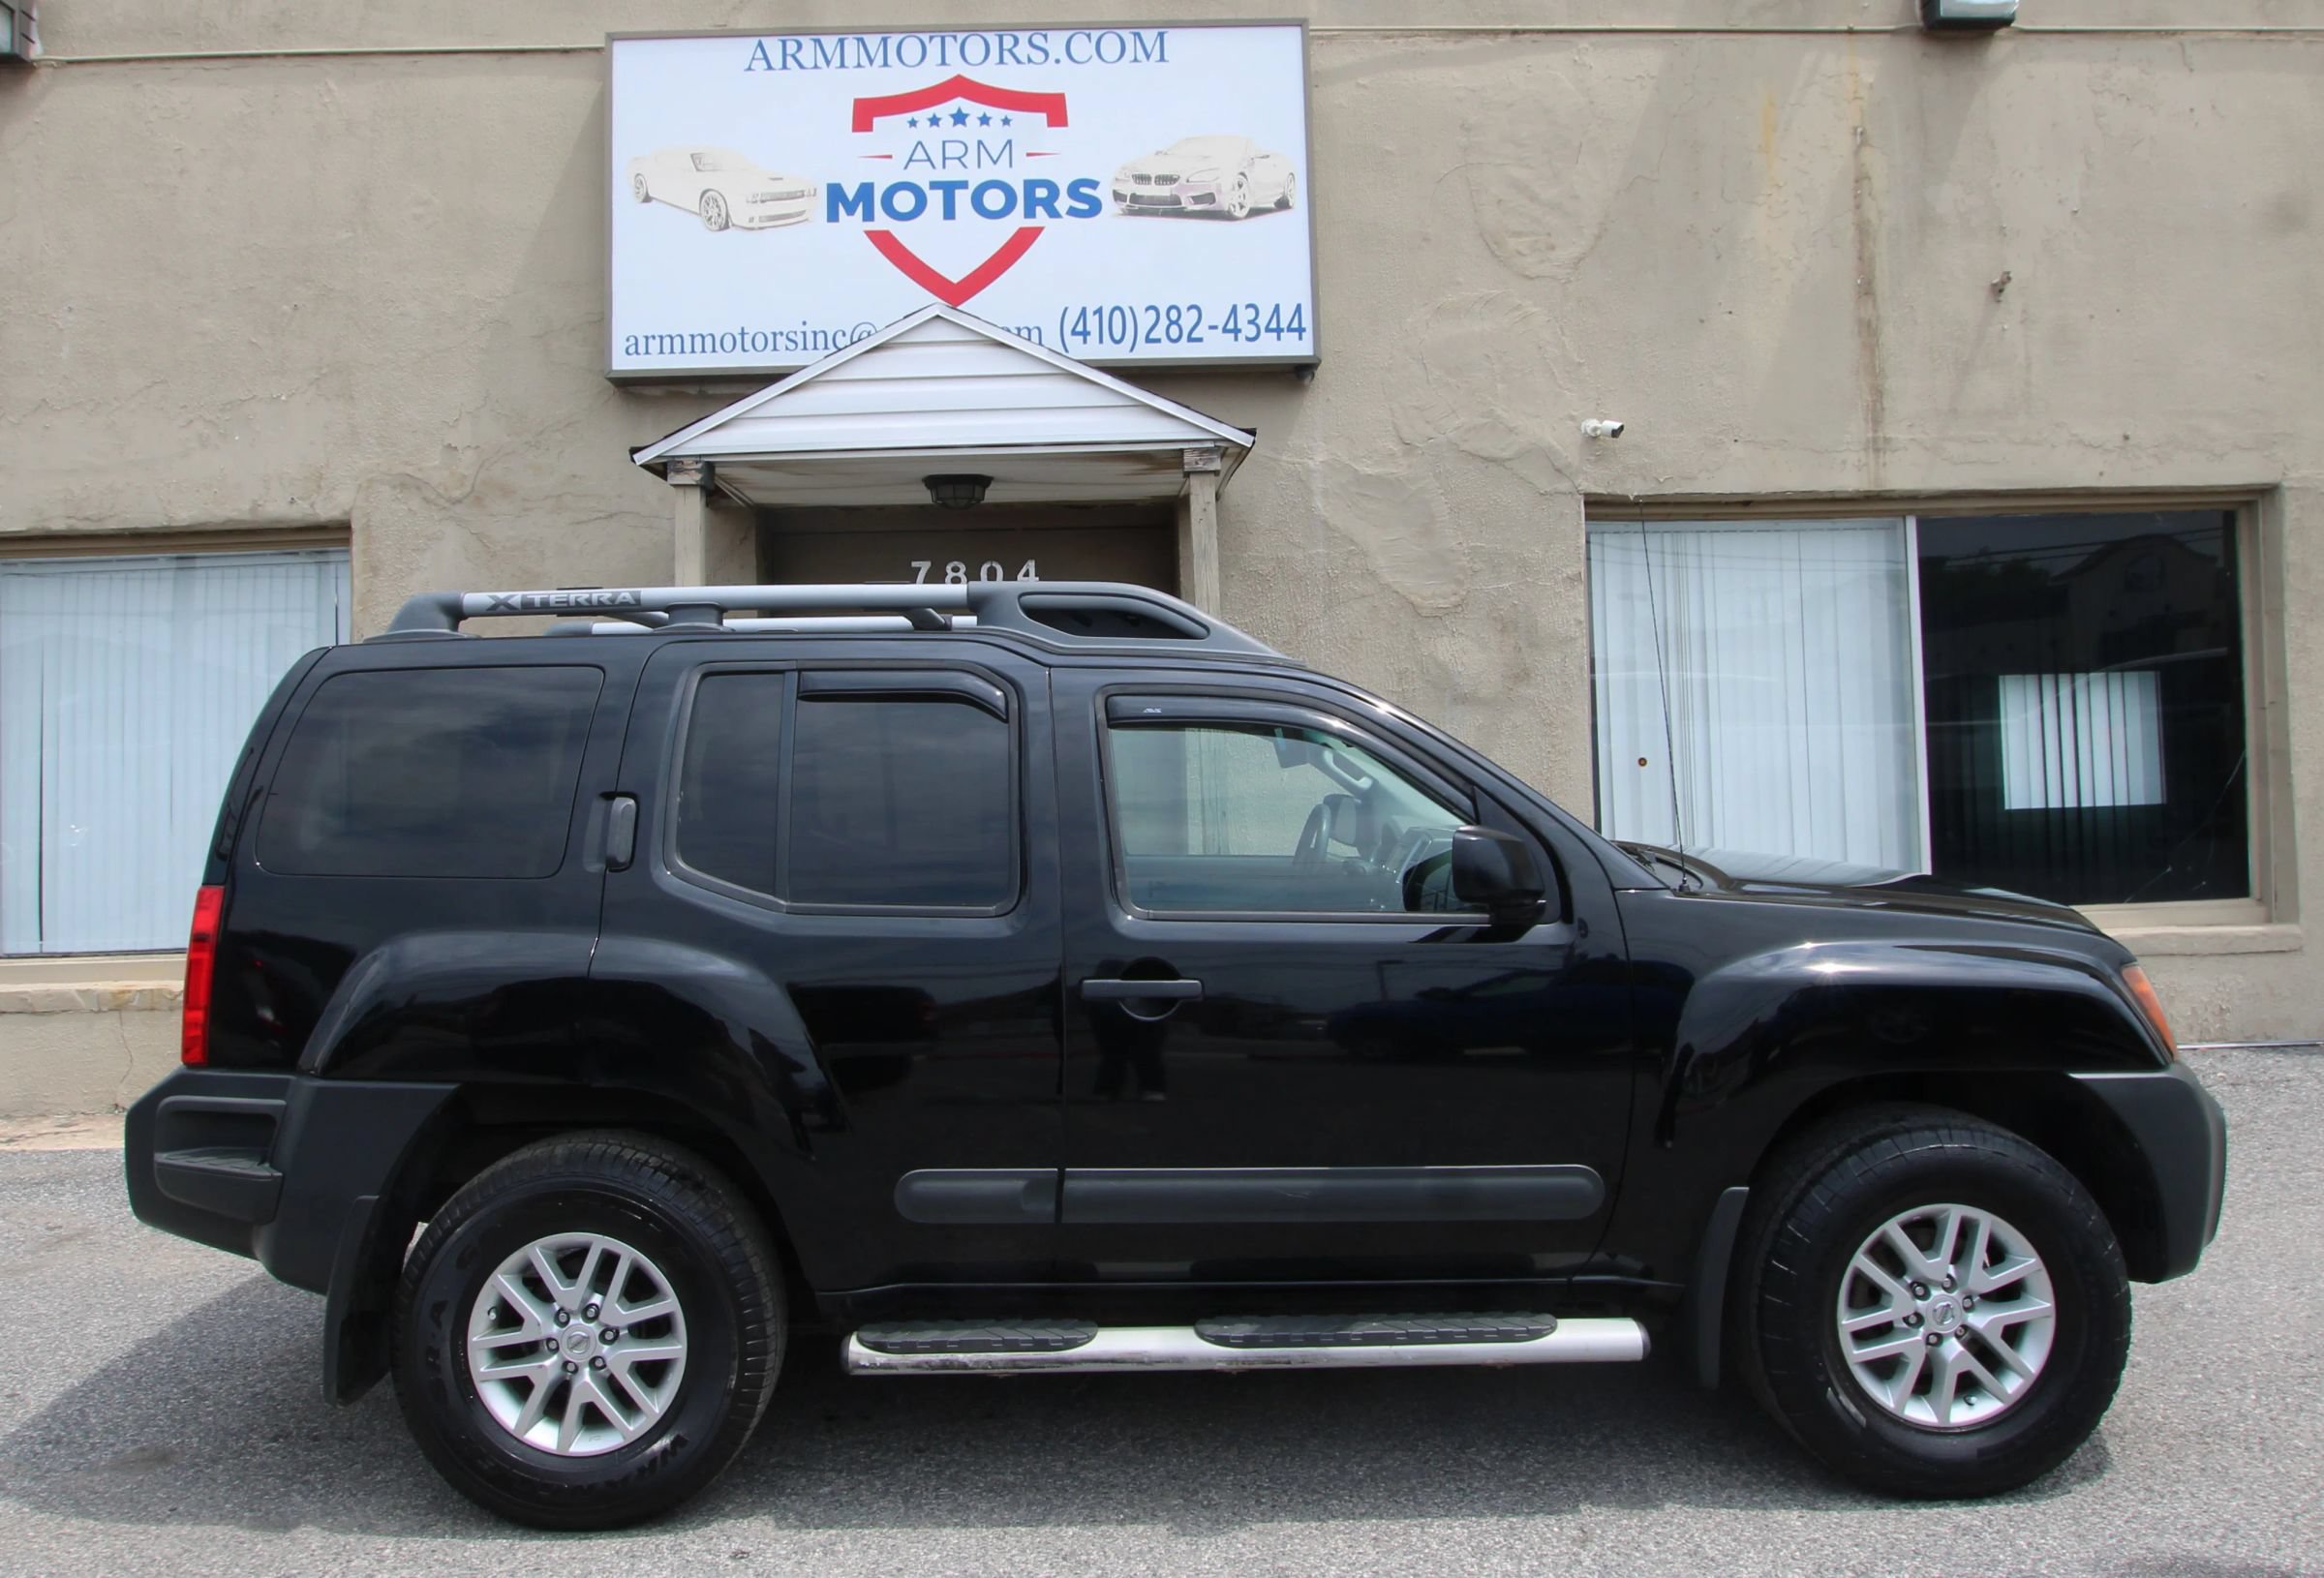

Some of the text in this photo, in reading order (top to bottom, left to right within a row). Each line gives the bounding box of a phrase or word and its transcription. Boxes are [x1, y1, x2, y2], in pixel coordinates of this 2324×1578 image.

[744, 31, 1170, 72] ARMMOTORS.COM
[903, 138, 1013, 170] ARM
[826, 178, 1103, 223] MOTORS
[1059, 303, 1307, 352] (410)282-4344
[911, 559, 1039, 585] 7804
[485, 592, 636, 612] XTERRA
